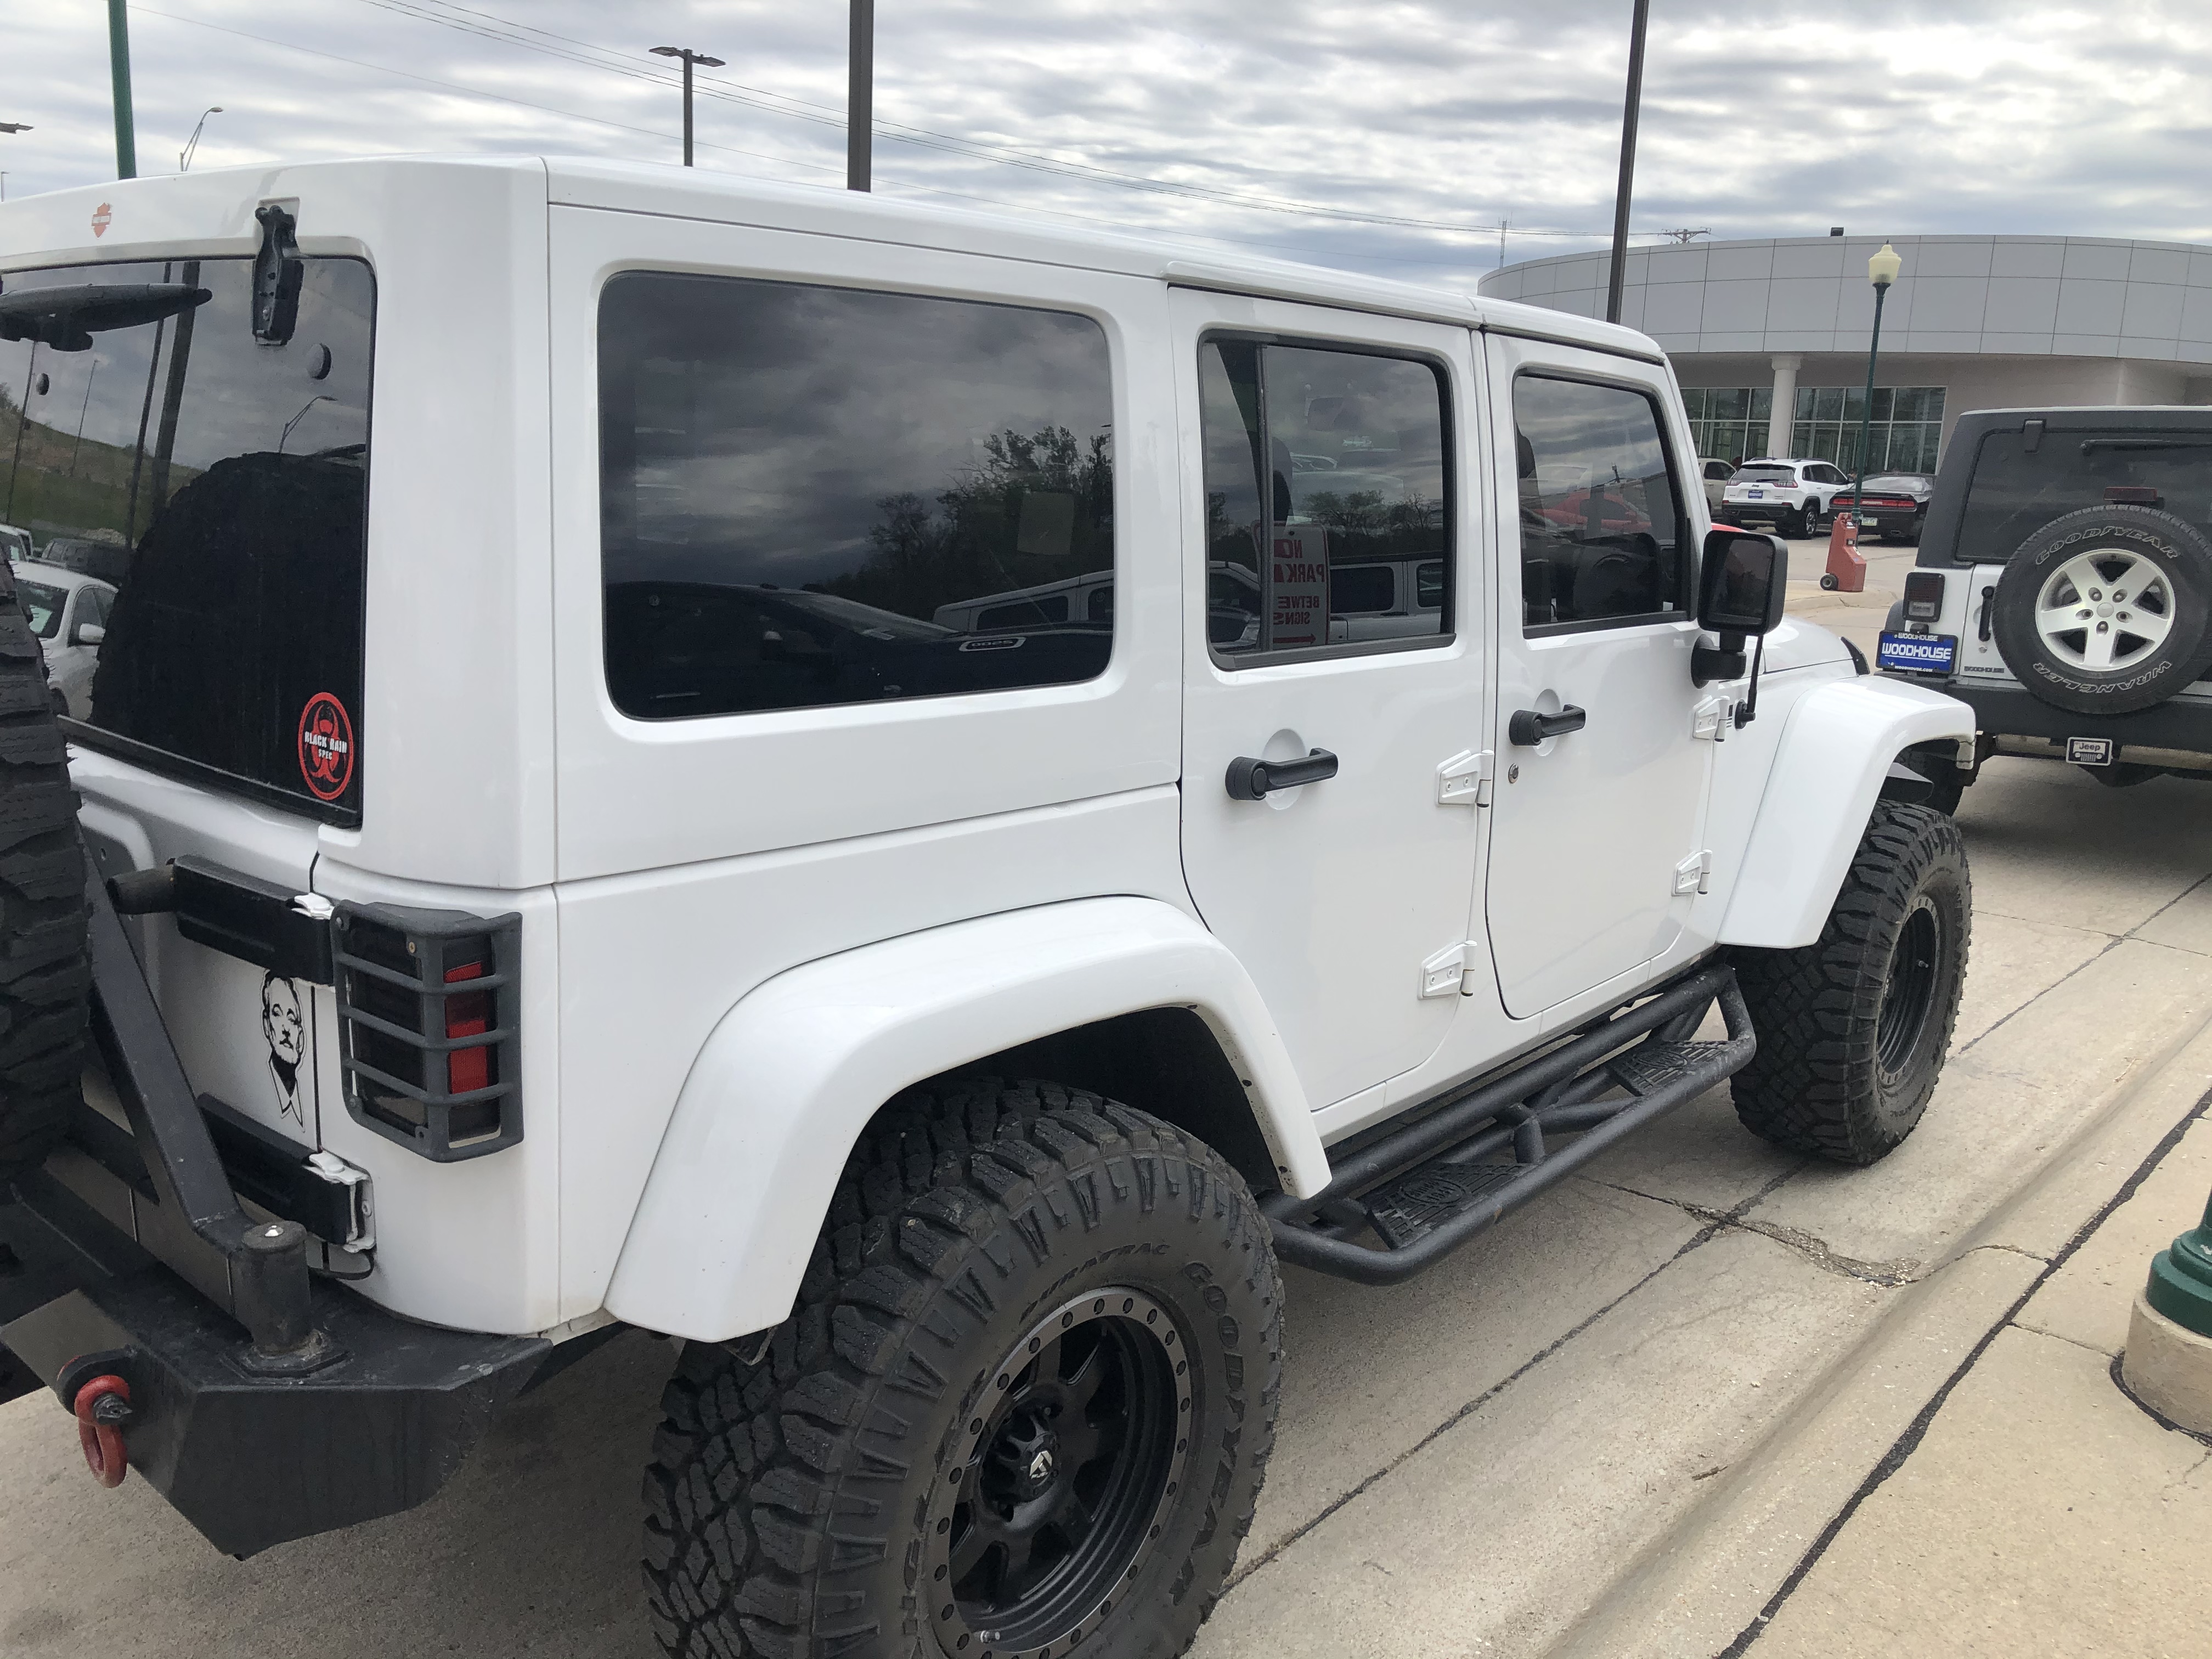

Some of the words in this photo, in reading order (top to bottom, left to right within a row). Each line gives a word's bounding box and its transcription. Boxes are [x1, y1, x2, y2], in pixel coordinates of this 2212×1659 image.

[2035, 526, 2180, 565] GOODYEAR
[1898, 633, 1938, 642] WOODHOUSE
[1881, 642, 1953, 660] WOODHOUSE
[2033, 661, 2172, 693] WRANGLER
[304, 731, 327, 748] BLACK
[330, 738, 347, 753] RAIN
[2079, 742, 2101, 752] Jeep
[318, 748, 332, 760] SPEC
